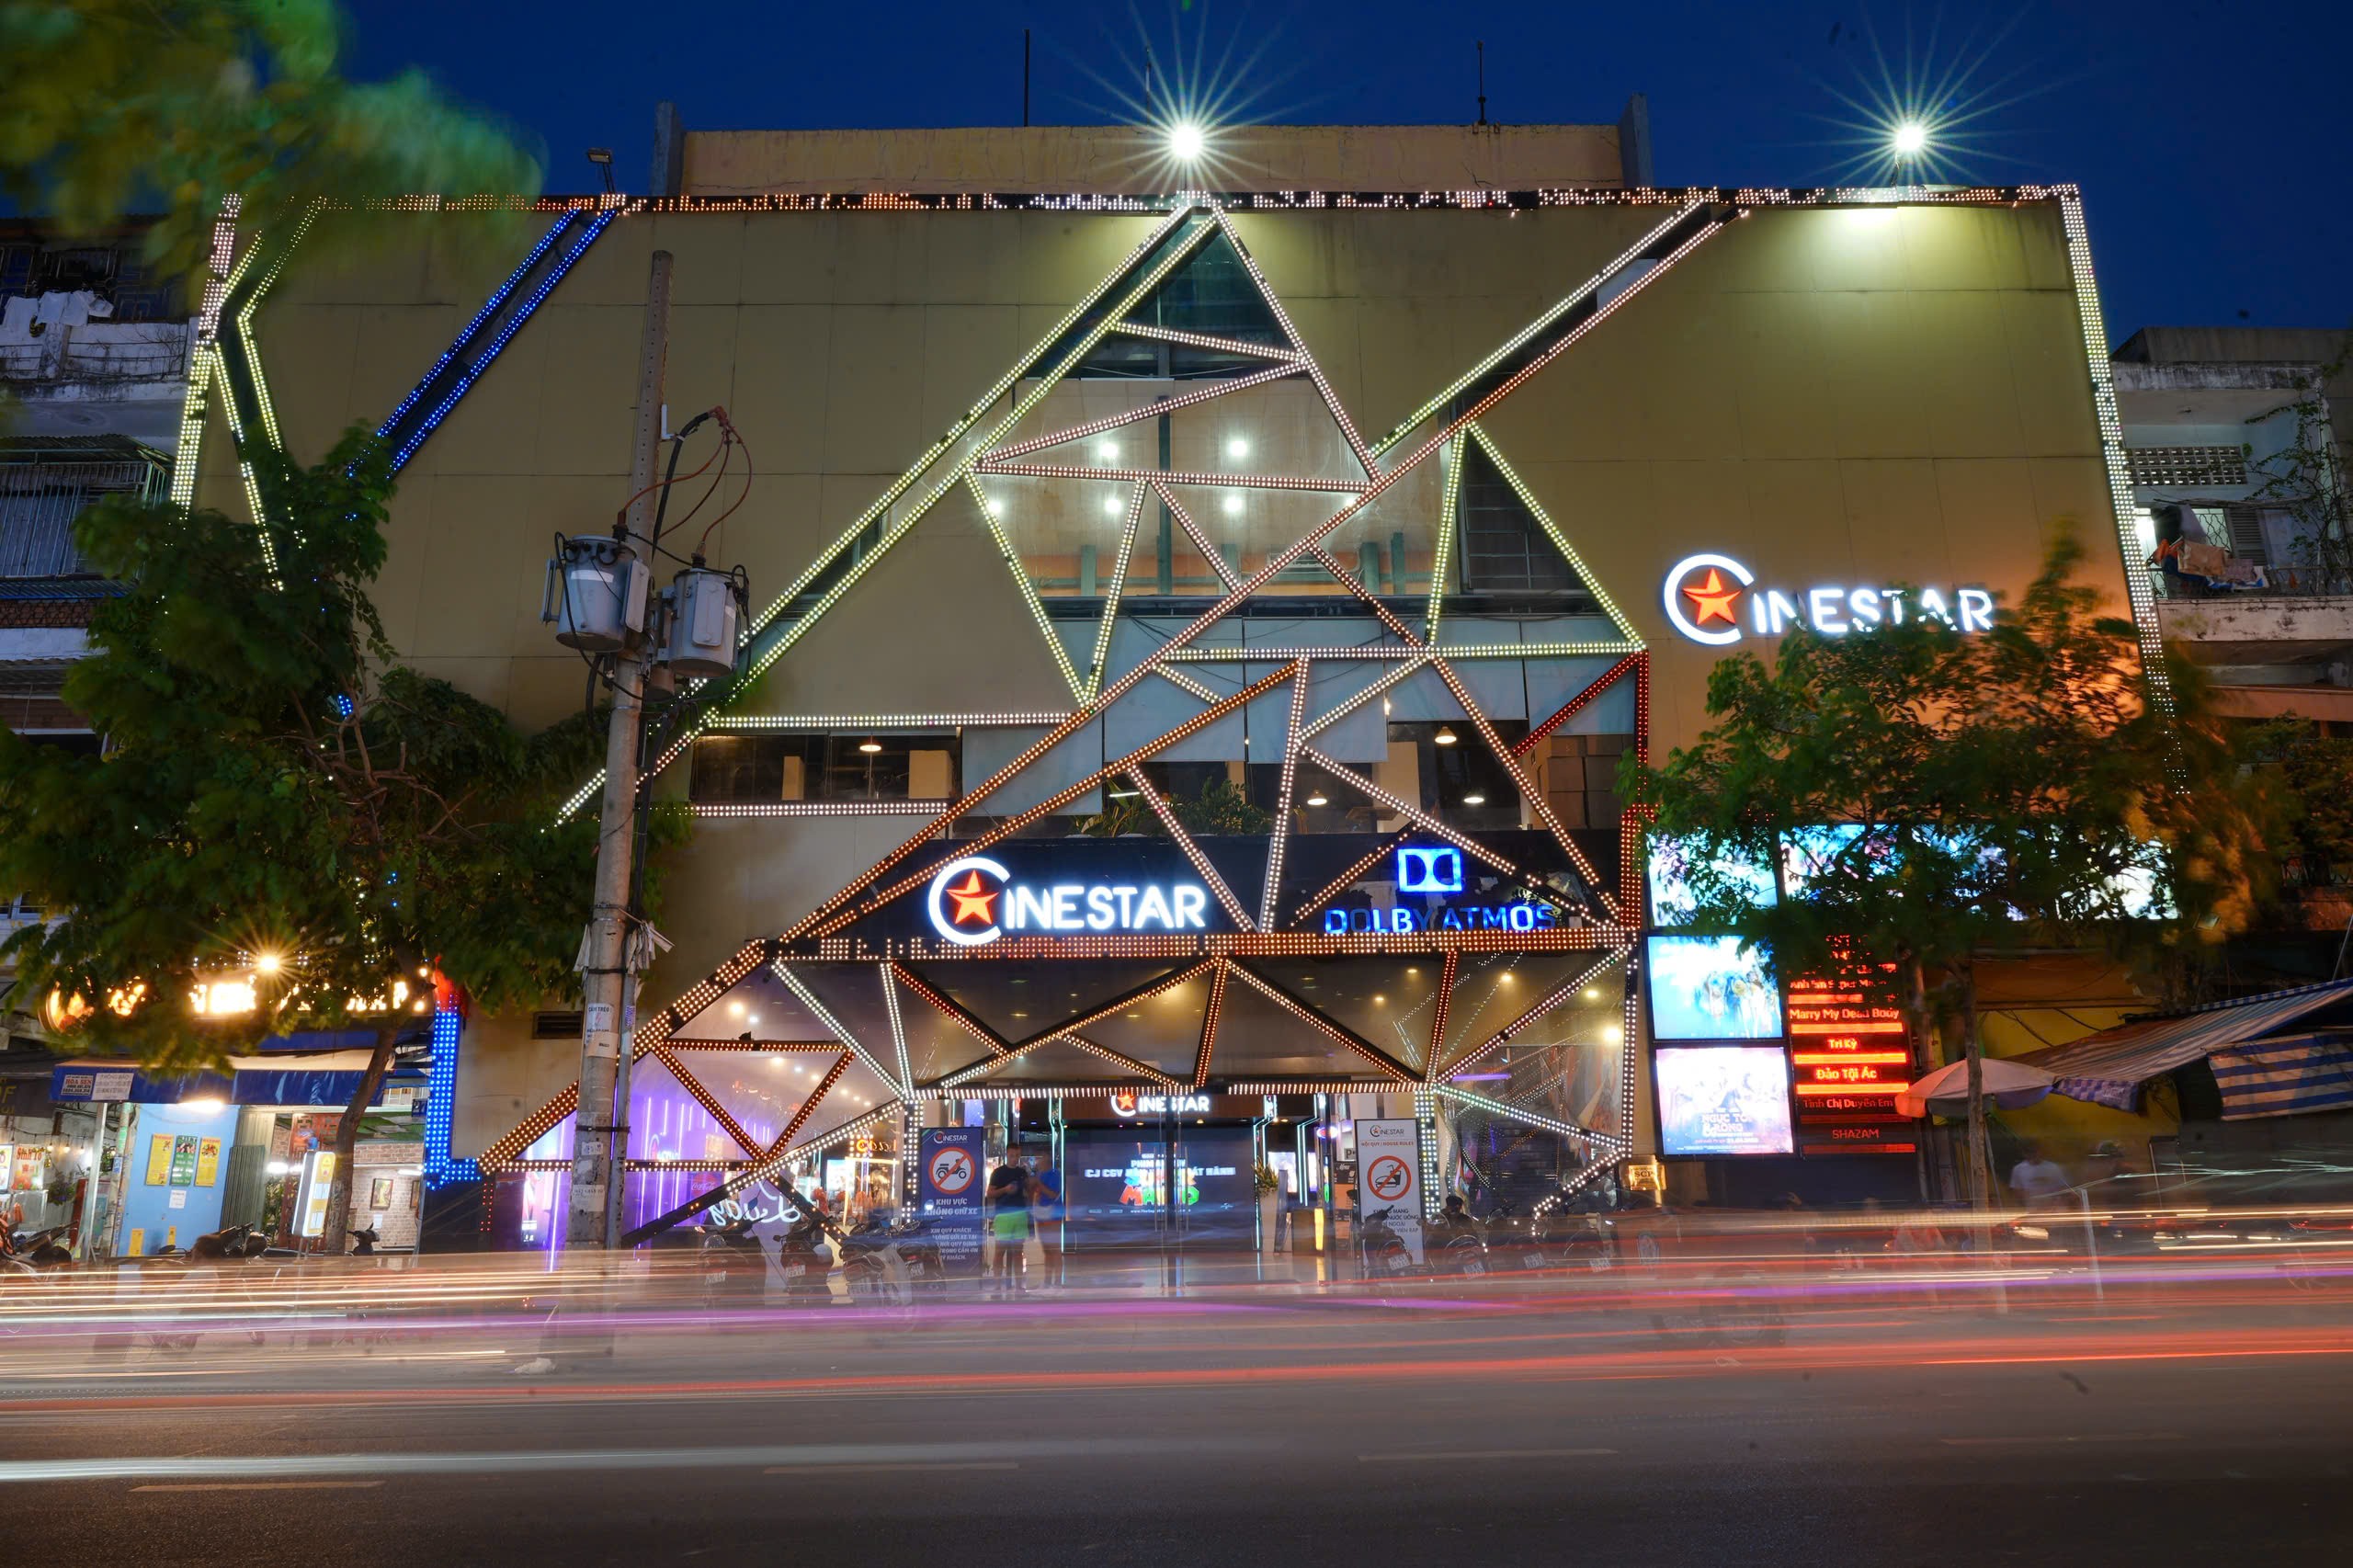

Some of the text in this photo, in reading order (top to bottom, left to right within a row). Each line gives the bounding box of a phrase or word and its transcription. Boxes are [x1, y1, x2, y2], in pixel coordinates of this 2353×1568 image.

[1664, 553, 1994, 645] CINESTAR
[927, 857, 1207, 946] CINESTAR
[1324, 905, 1556, 934] DOLBY ATMOS
[1790, 1009, 1820, 1021] Marry
[1824, 1009, 1839, 1020] My
[1842, 1009, 1870, 1018] Dead
[1842, 1068, 1859, 1081] Tội
[1861, 1066, 1877, 1079] Ác
[1826, 1098, 1842, 1109] Chị
[1878, 1099, 1893, 1108] Em
[934, 1131, 968, 1144] CINESTAR
[1370, 1124, 1404, 1138] CINESTAR
[1832, 1129, 1880, 1139] SHAZAM
[1085, 1169, 1100, 1177] CJ
[1102, 1168, 1122, 1177] CGV
[952, 1198, 968, 1207] VỰC
